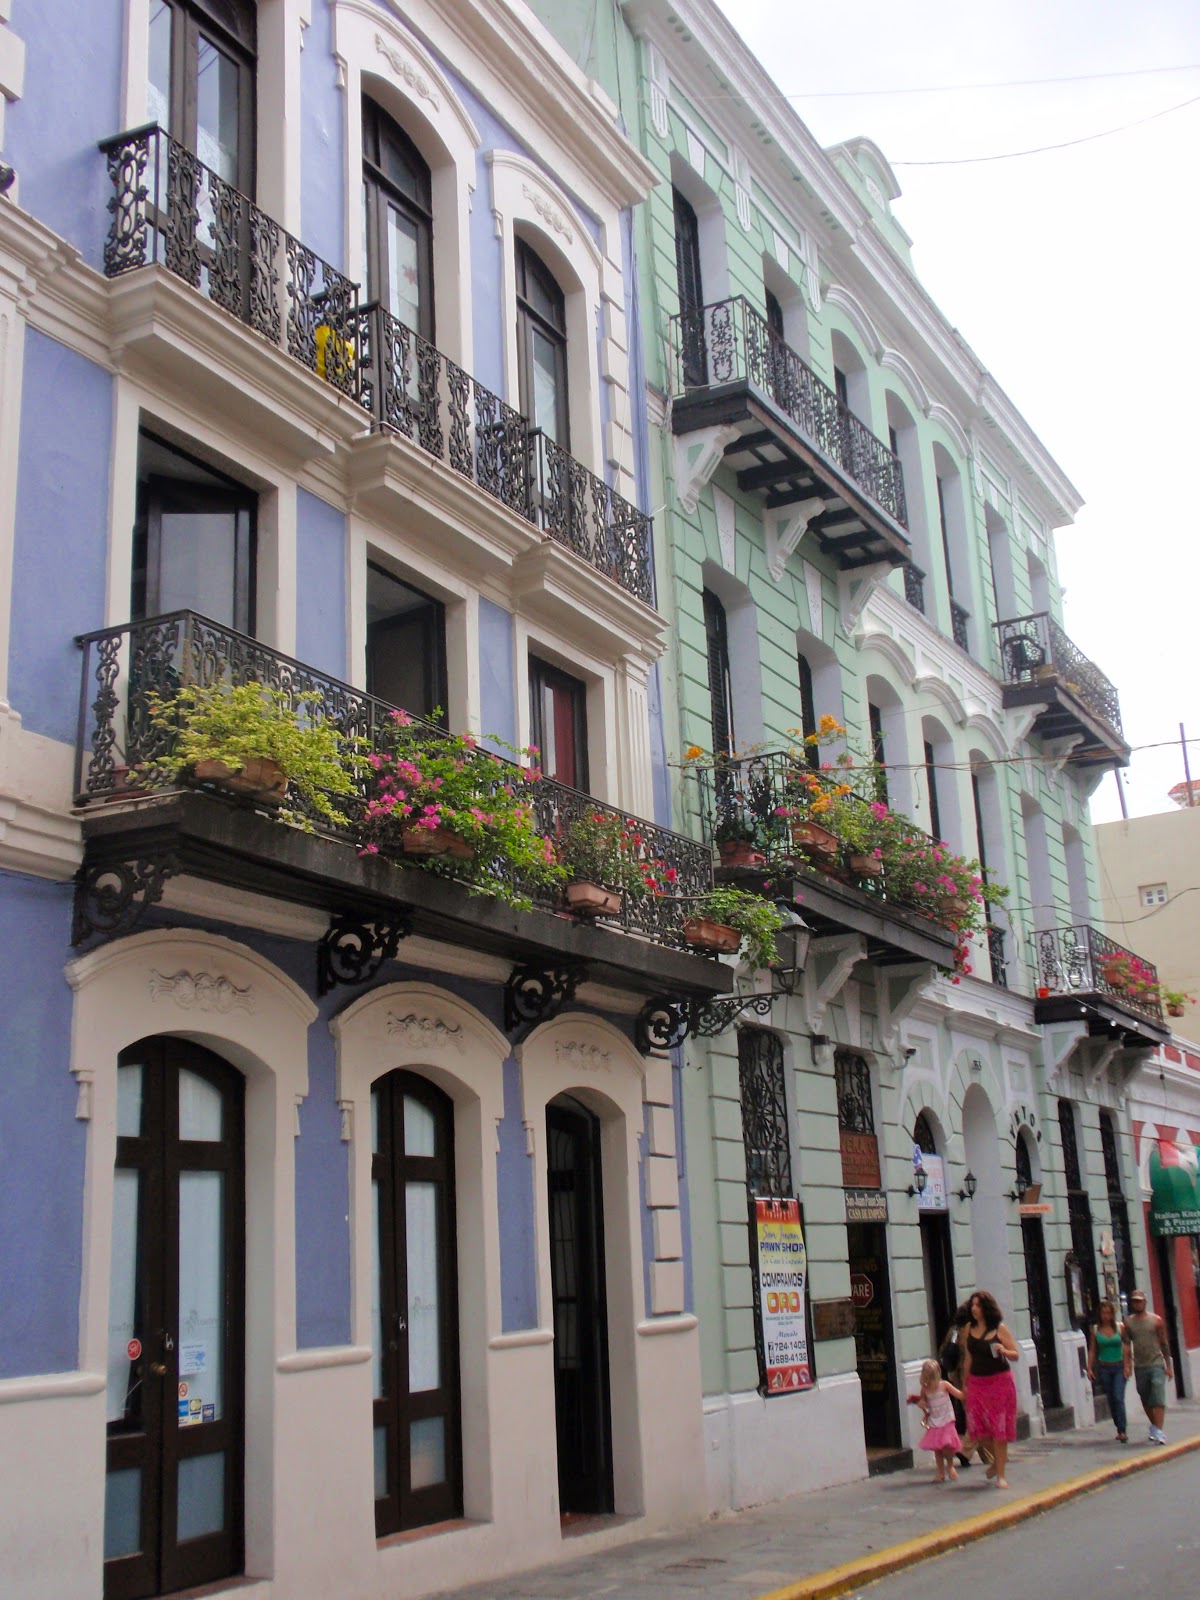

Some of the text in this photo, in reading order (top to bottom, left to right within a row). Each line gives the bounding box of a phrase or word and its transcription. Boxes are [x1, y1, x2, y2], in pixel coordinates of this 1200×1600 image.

[1154, 1211, 1181, 1219] Italian
[1164, 1218, 1171, 1226] &
[762, 1223, 799, 1242] San Juan
[760, 1242, 804, 1253] PAWN SHOP
[762, 1272, 803, 1288] COMPRAMOS
[767, 1291, 800, 1314] ORO
[774, 1340, 806, 1352] 724-1402
